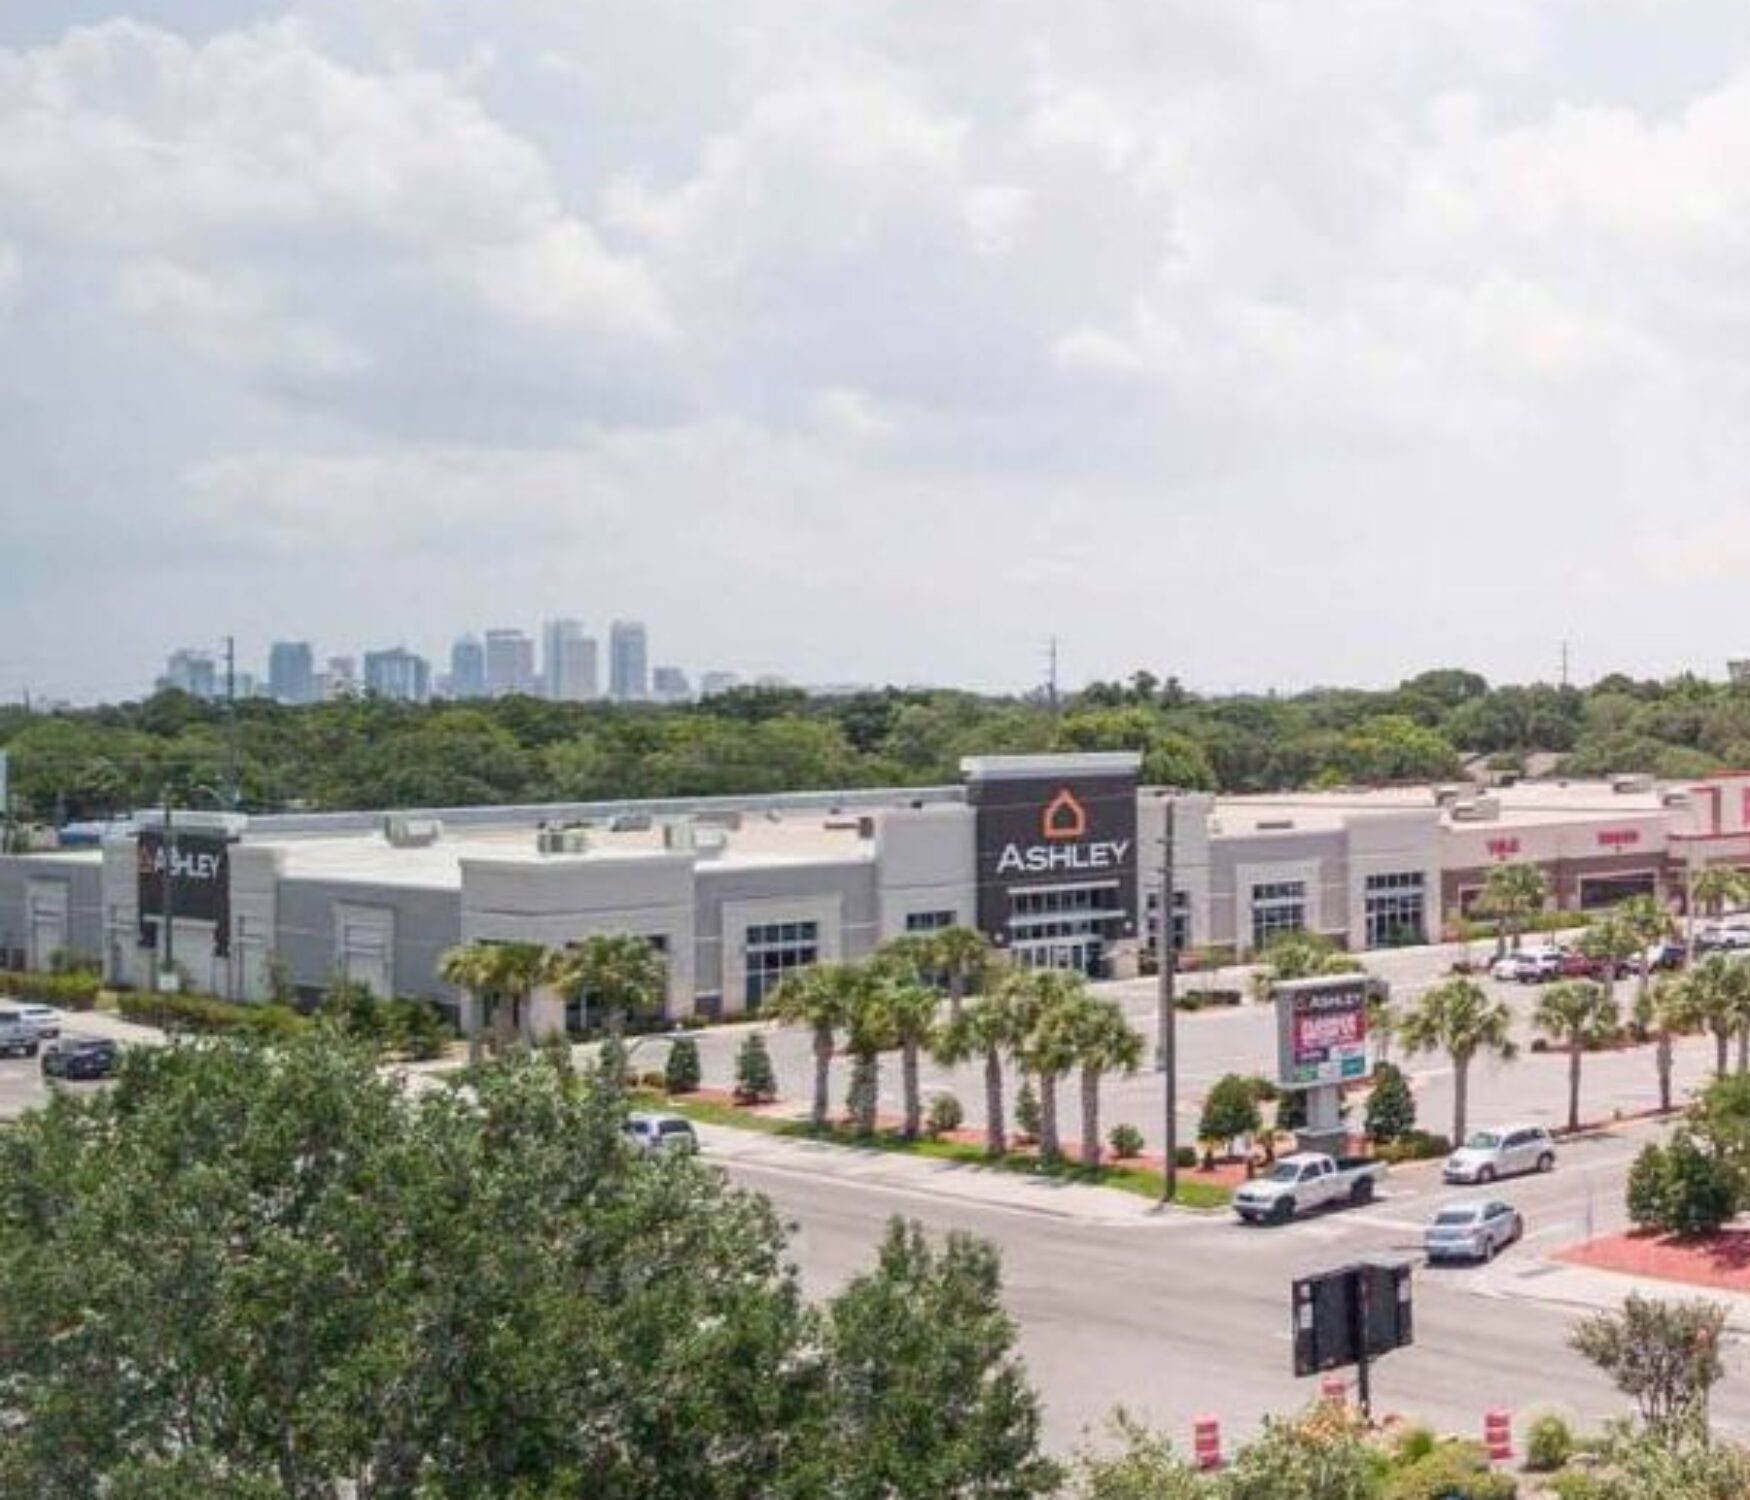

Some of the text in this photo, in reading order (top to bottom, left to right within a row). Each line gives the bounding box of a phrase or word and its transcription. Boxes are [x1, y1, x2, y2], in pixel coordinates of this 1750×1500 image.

[153, 845, 220, 878] ASHLEY
[997, 841, 1129, 873] ASHLEY
[1310, 992, 1362, 1009] ASHLEY
